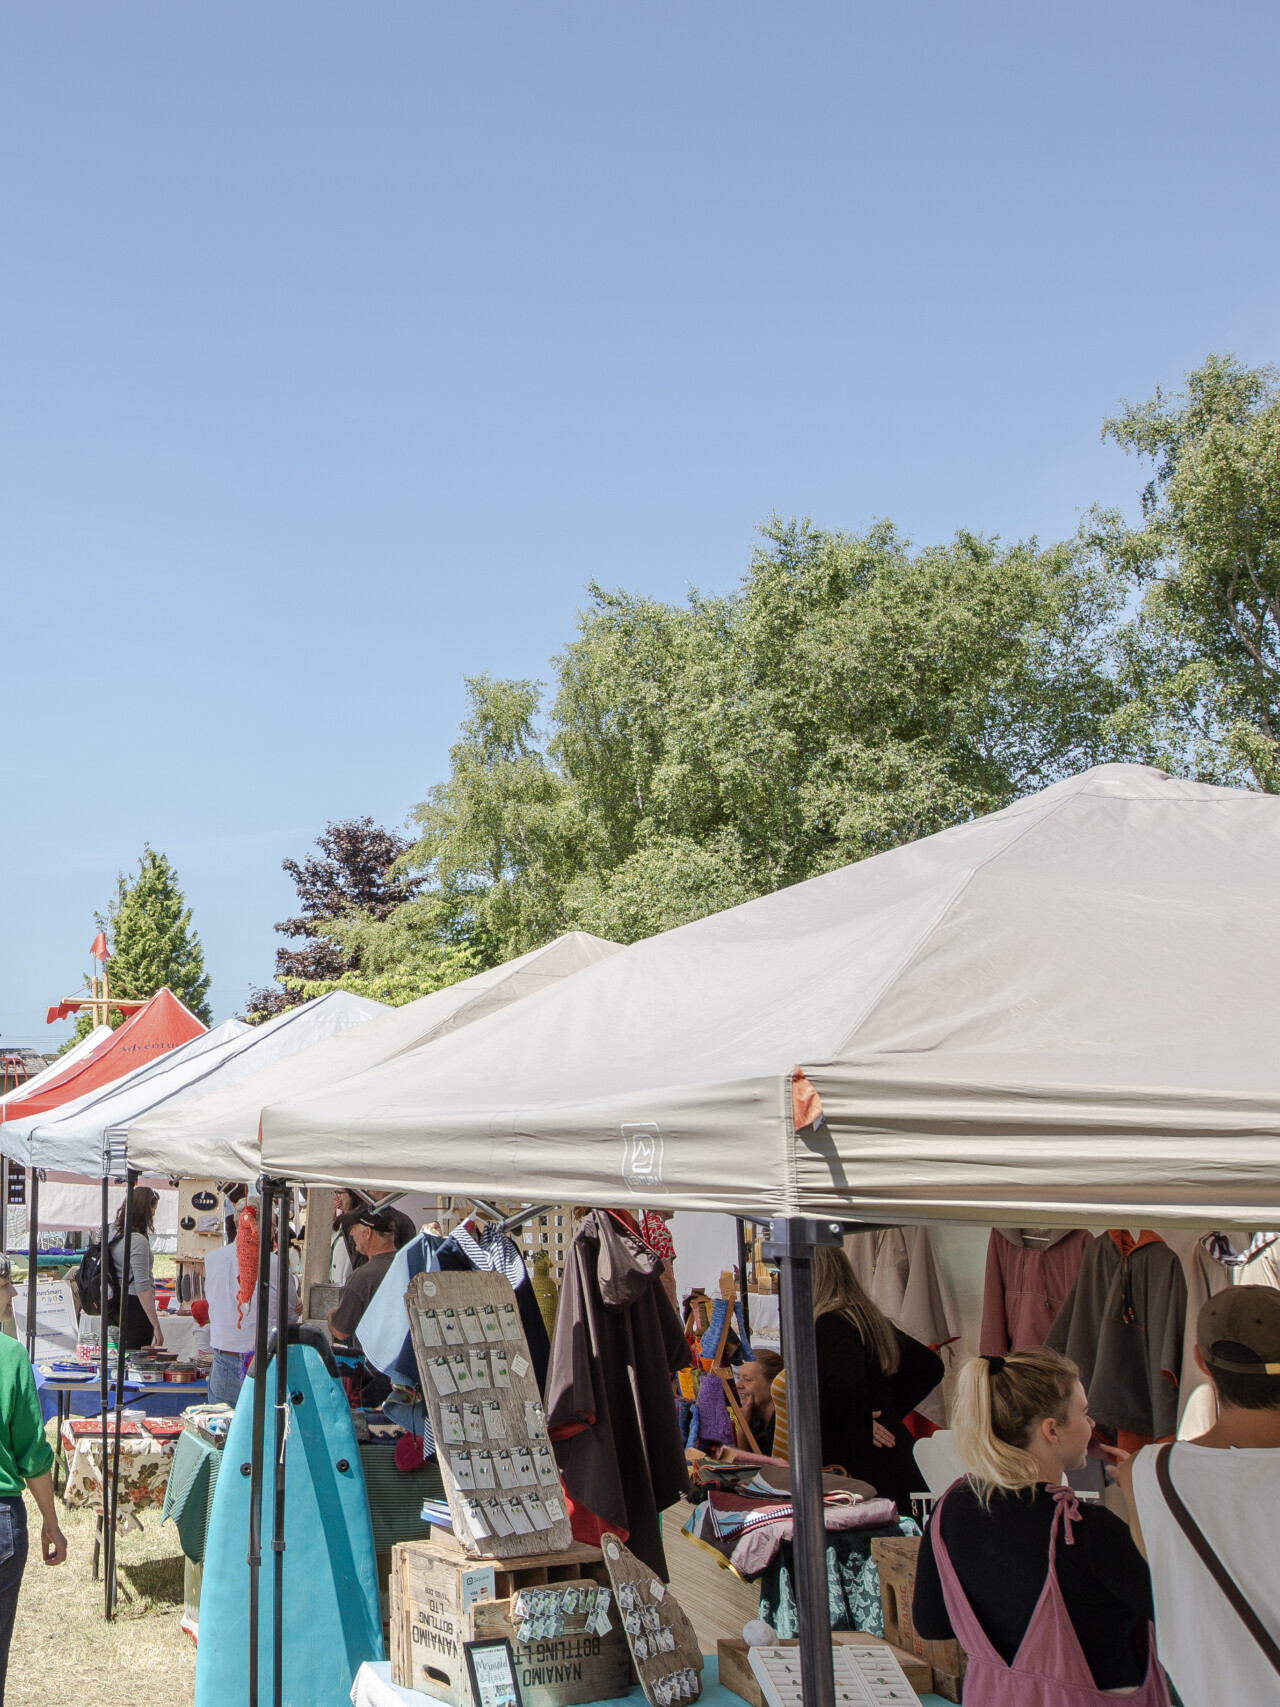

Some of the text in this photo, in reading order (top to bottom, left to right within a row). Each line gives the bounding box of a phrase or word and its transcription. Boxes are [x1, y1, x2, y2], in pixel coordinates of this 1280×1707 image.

[418, 1611, 454, 1635] BOTTLING
[513, 1637, 601, 1666] BOTTLING LT
[522, 1662, 582, 1688] NANAIMO
